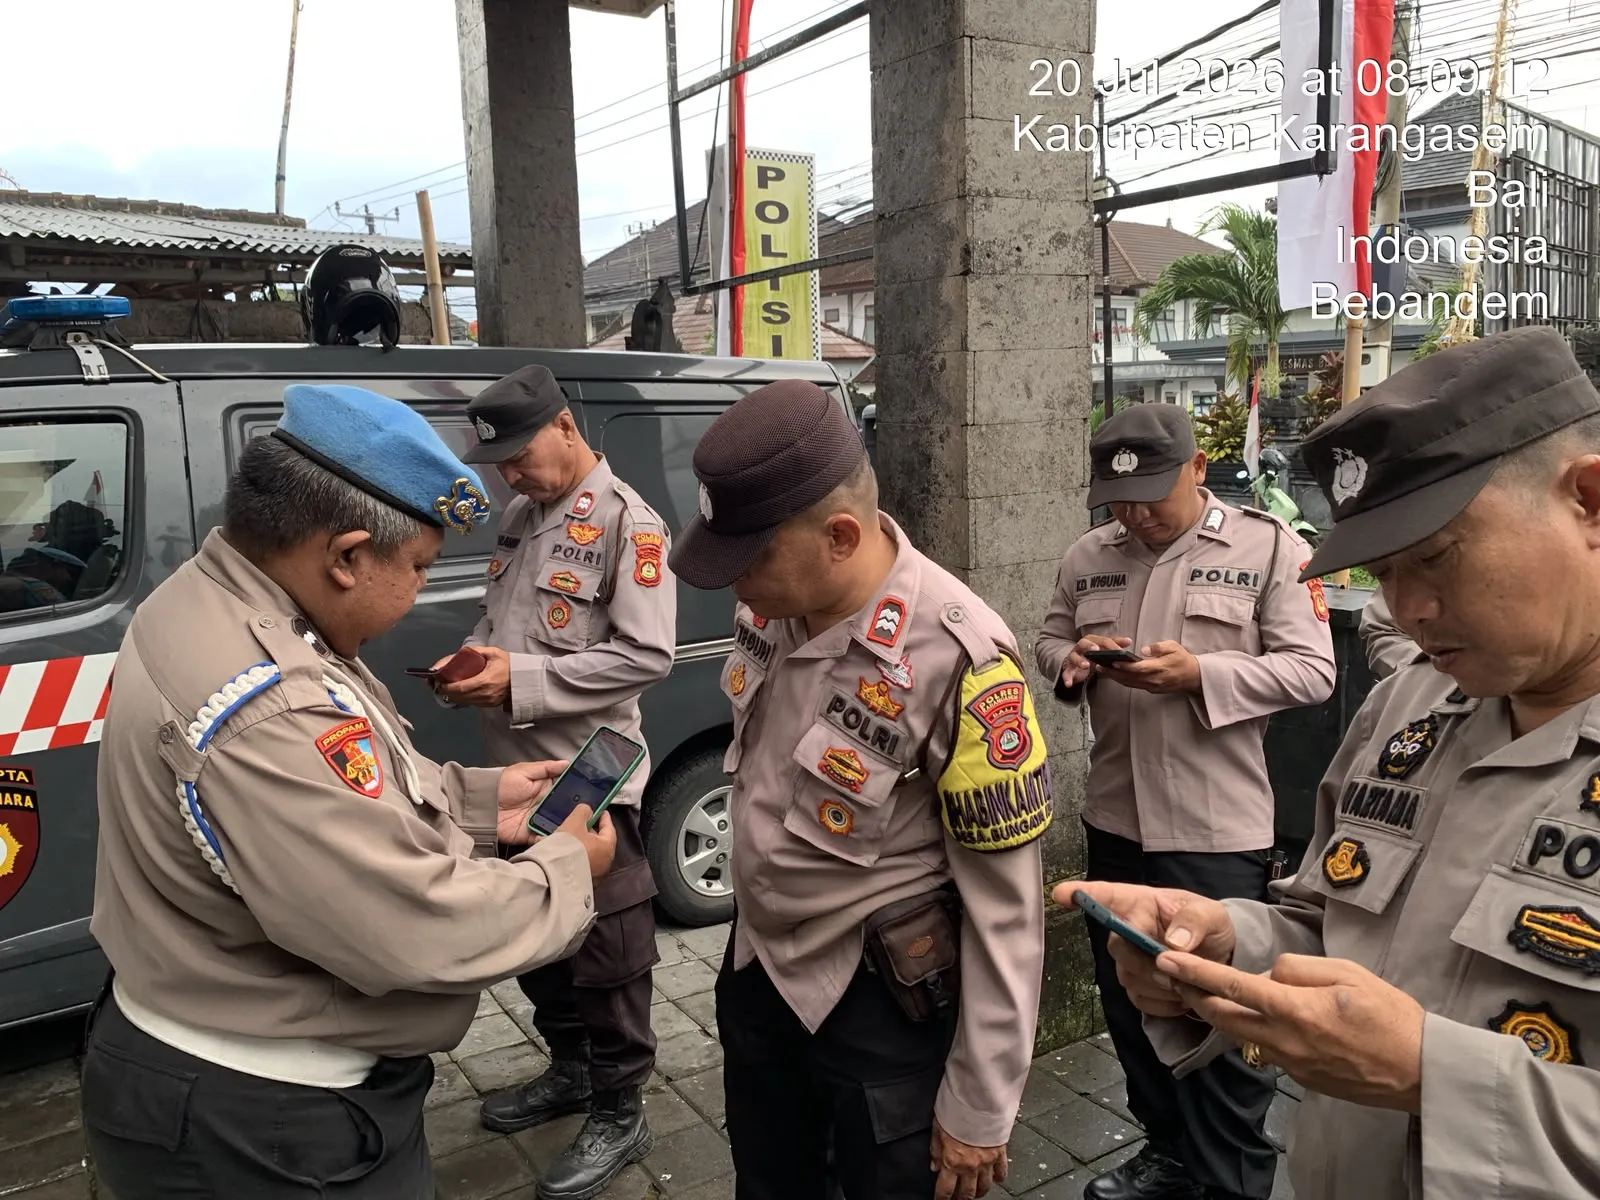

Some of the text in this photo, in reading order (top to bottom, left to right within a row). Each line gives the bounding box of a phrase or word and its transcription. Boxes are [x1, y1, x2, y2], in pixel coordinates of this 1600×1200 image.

[754, 165, 791, 357] POLISI
[551, 543, 602, 566] POLRI
[1190, 568, 1259, 588] POLRI
[978, 687, 1019, 711] POLRES
[322, 722, 365, 747] PROPAM
[826, 694, 899, 755] POLRI
